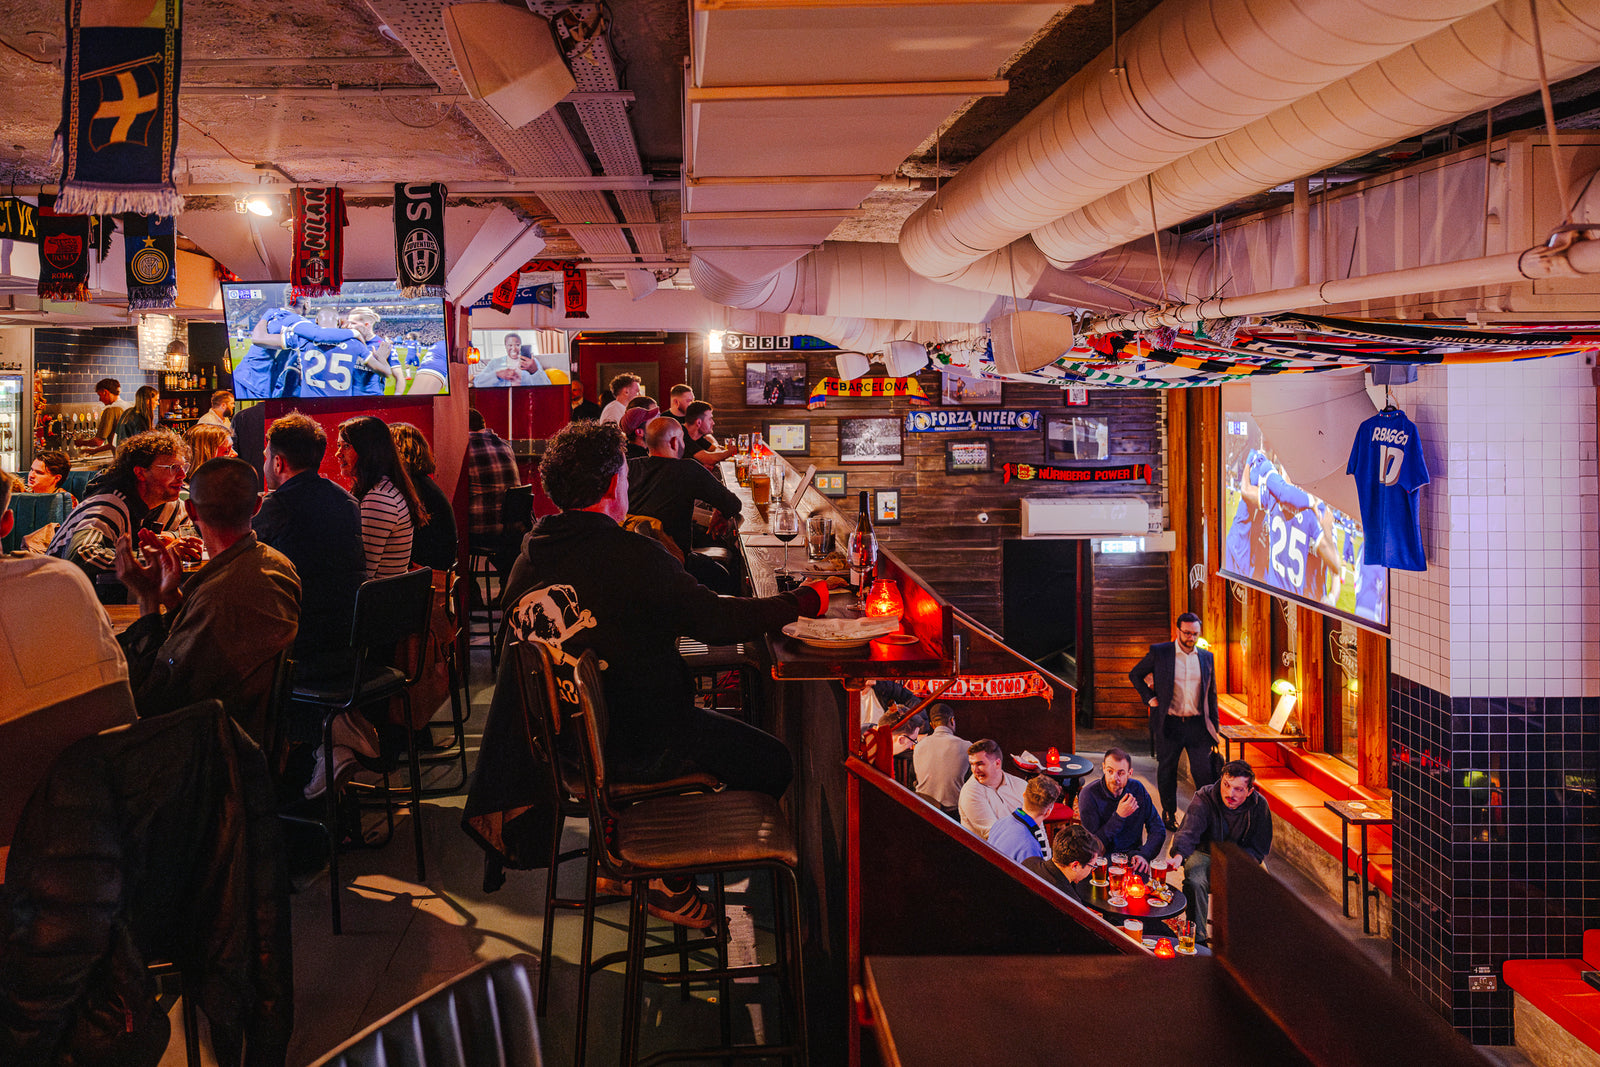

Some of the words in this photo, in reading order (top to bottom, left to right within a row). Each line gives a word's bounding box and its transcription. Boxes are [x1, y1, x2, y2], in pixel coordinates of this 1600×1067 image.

[304, 187, 327, 249] MILAN
[406, 241, 435, 249] JUVENTUS
[303, 349, 352, 391] 25
[930, 411, 974, 426] FORZA
[978, 411, 1017, 425] INTER
[1038, 467, 1091, 481] NÜRNBERG
[1094, 469, 1130, 480] POWER
[1271, 515, 1307, 588] 25
[932, 681, 962, 694] FZA
[990, 679, 1021, 694] ROMA
